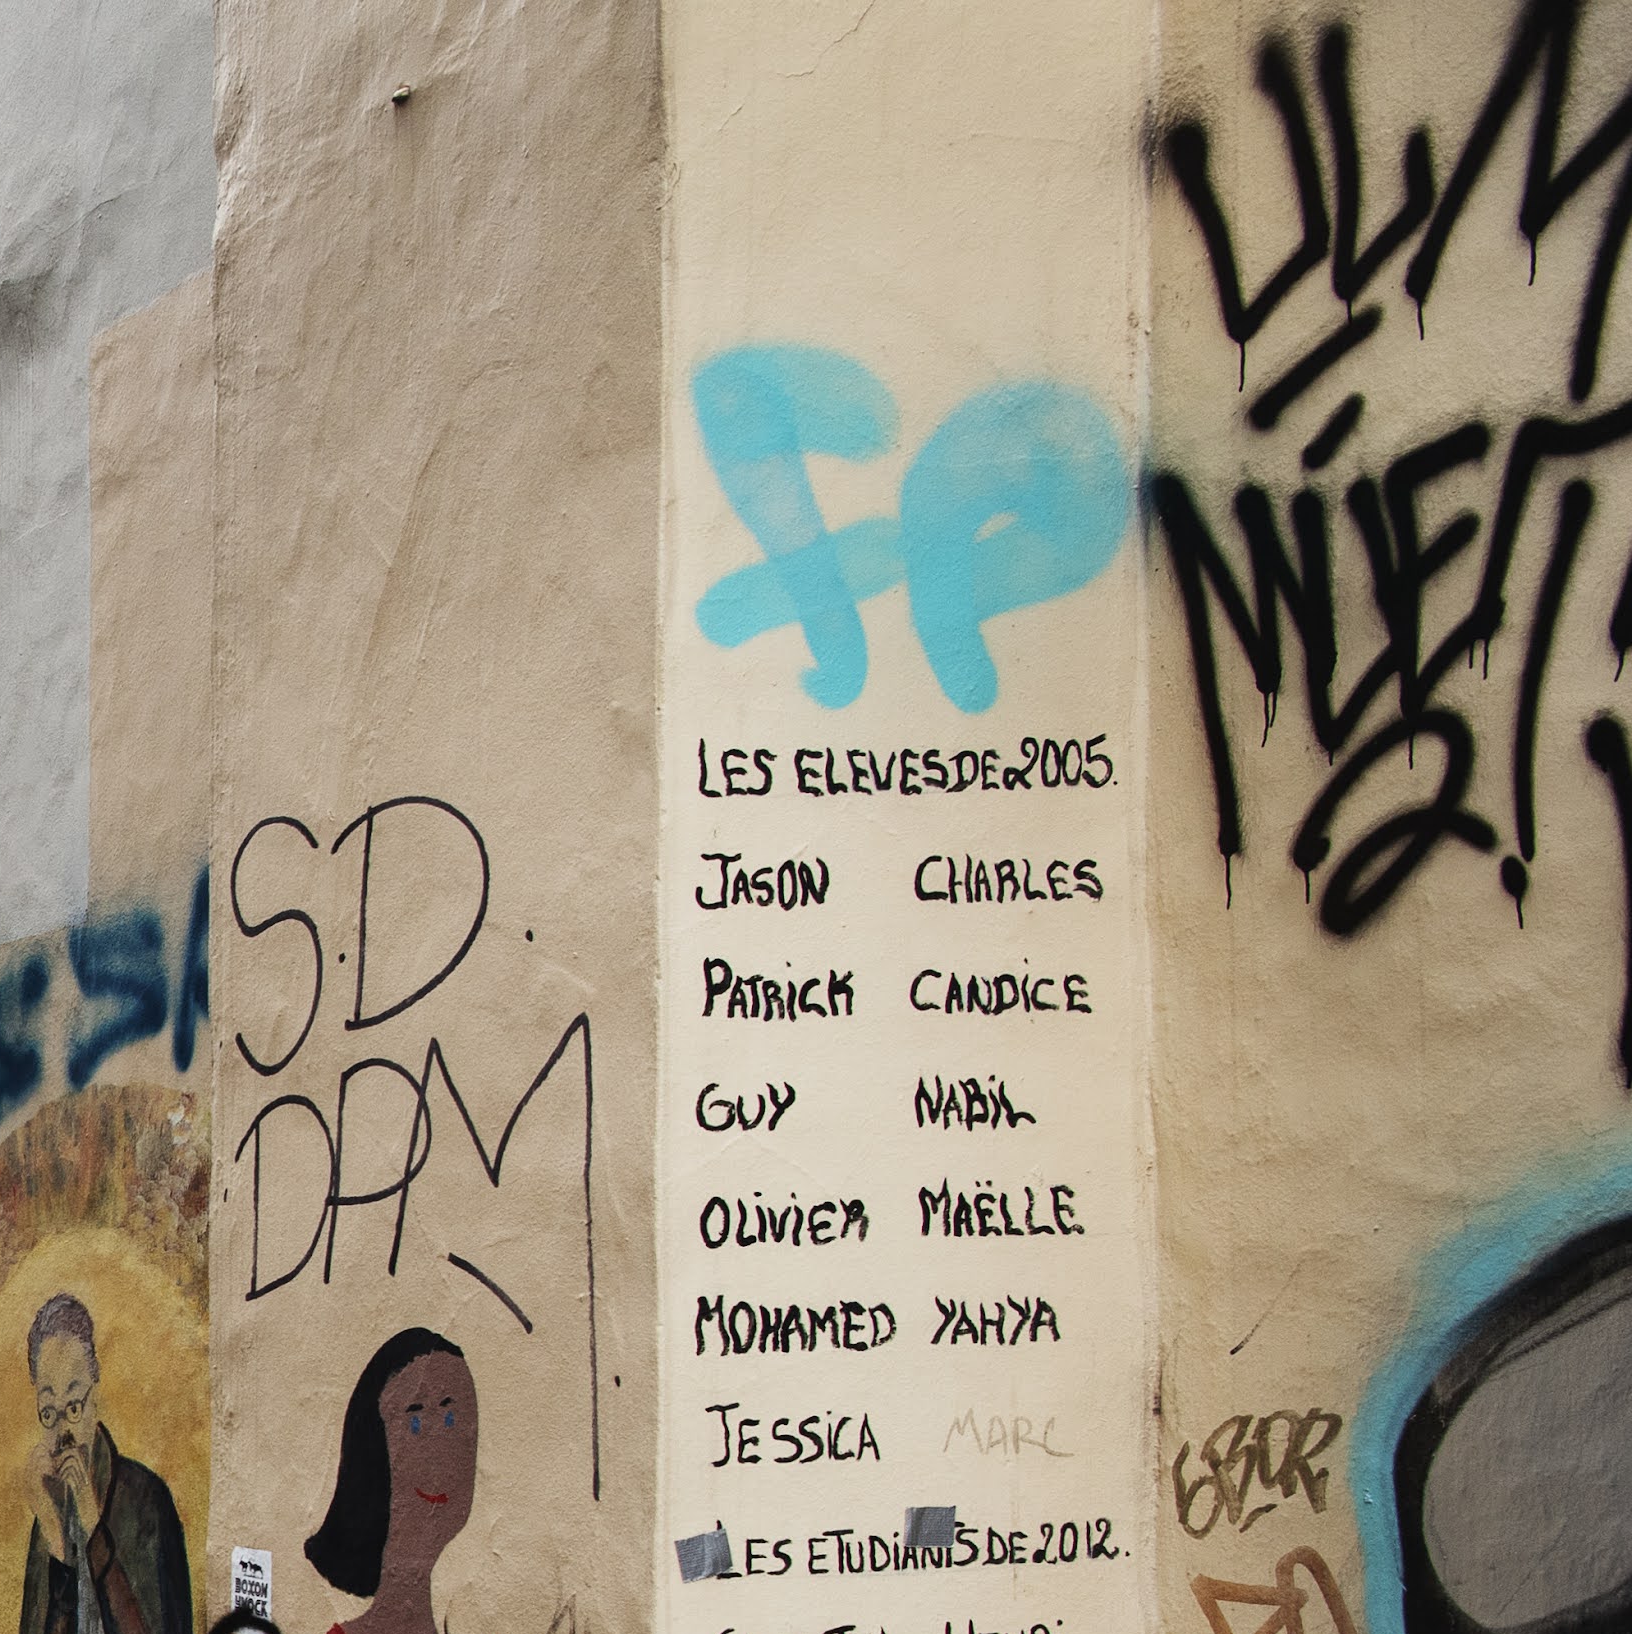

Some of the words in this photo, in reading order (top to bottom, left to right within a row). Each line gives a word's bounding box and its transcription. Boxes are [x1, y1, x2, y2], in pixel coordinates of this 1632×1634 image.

[699, 737, 777, 798] LES
[795, 747, 950, 796] ELEVES
[948, 748, 1001, 793] DE
[695, 853, 830, 911] JASON
[914, 855, 1105, 904] CHARLES
[695, 1082, 797, 1132] GUY
[918, 1178, 1085, 1237] MAËLLE
[695, 1294, 898, 1357] MOHAMED
[930, 1296, 1062, 1347] YAHYA
[941, 1407, 1075, 1458] MARC
[988, 1530, 1028, 1567] DE
